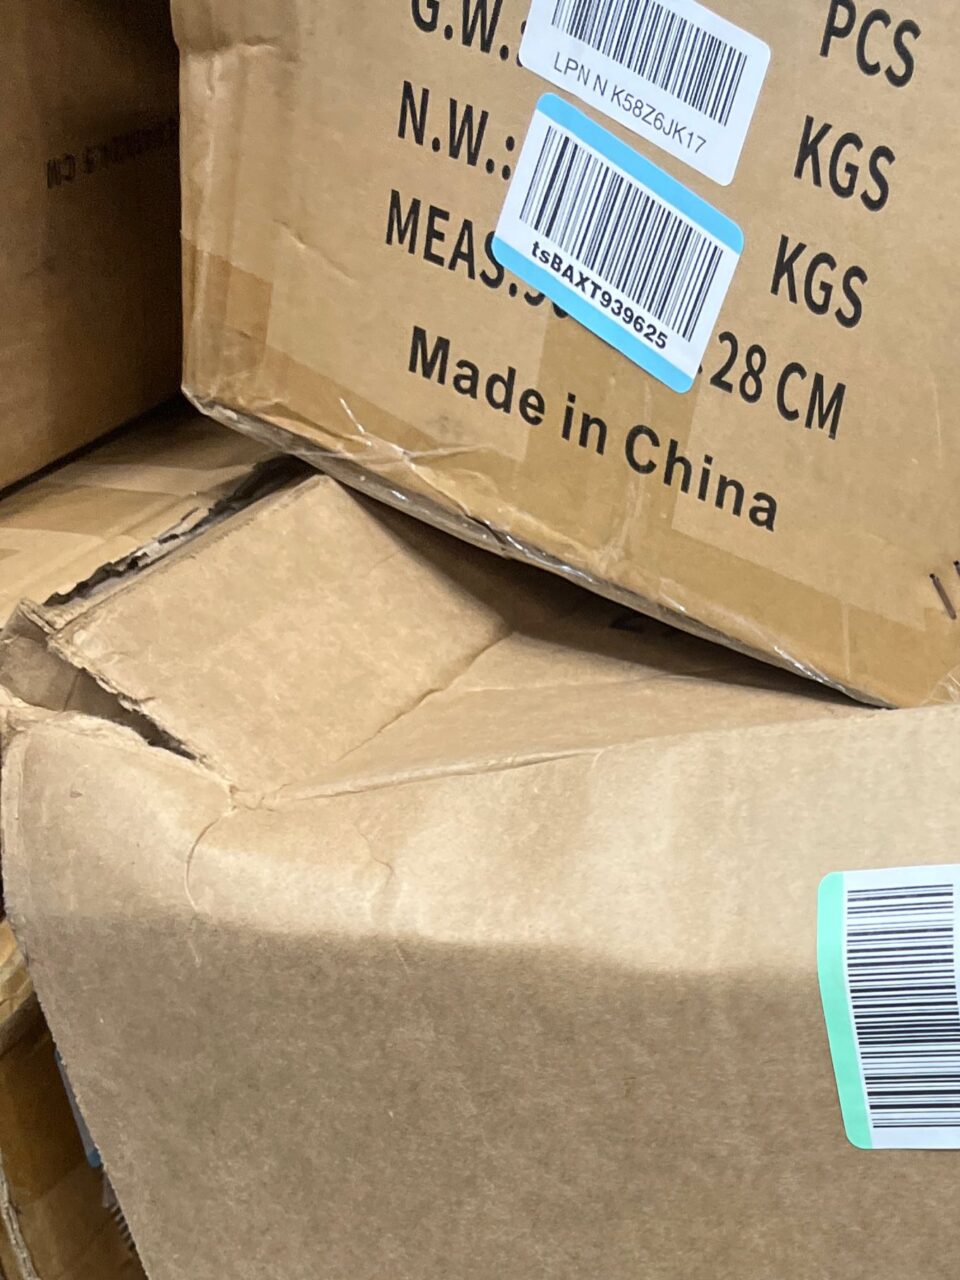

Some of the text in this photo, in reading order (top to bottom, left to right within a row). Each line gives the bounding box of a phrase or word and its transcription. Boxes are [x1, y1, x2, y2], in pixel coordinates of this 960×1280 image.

[820, 0, 921, 88] PCS
[398, 80, 515, 181] N.W.:
[553, 51, 707, 155] LPN N K58Z6JK17
[794, 114, 895, 212] KGS
[531, 239, 669, 350] tsBAXT939625
[770, 234, 868, 328] KGS
[408, 326, 779, 532] Made in China
